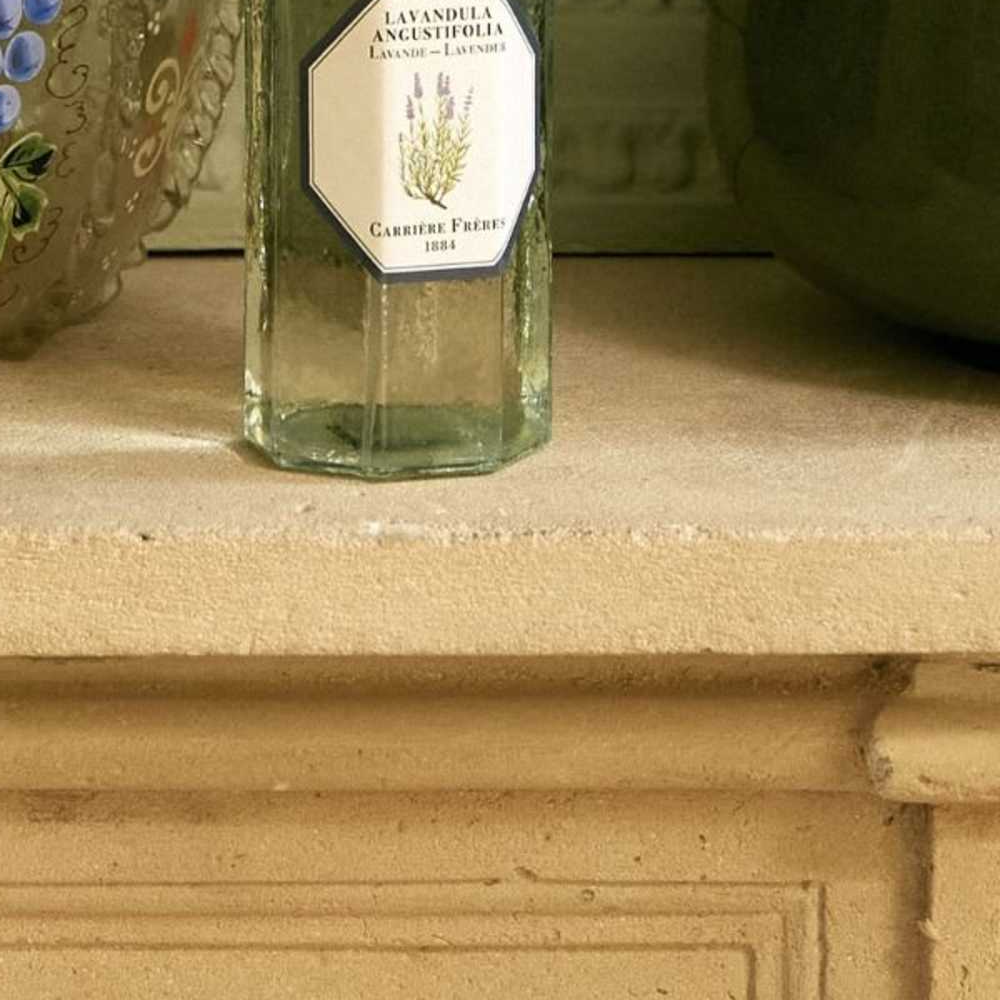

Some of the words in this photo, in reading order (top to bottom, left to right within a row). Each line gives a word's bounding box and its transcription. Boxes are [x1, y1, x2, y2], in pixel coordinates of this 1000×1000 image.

[385, 6, 492, 25] LAVANDULA
[372, 23, 503, 43] ANGUSTIFOLIA
[369, 45, 427, 60] LAVANDE
[369, 220, 447, 238] CARRIÈRE
[451, 217, 506, 233] FRÈRES
[425, 239, 456, 252] 1884
